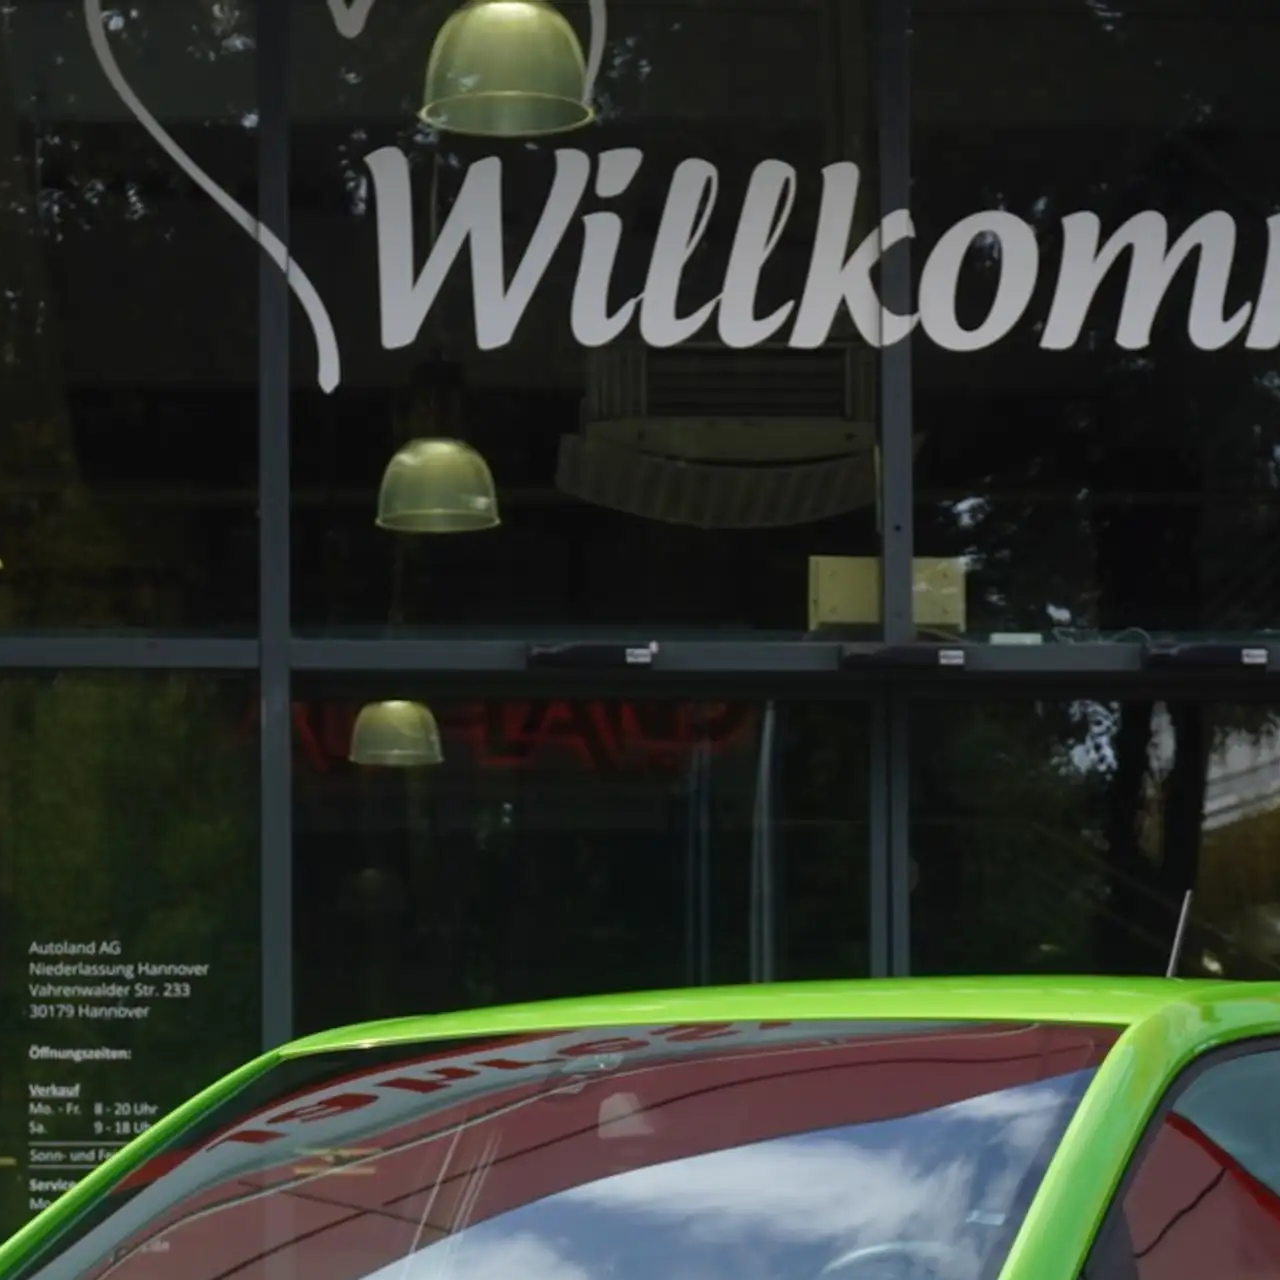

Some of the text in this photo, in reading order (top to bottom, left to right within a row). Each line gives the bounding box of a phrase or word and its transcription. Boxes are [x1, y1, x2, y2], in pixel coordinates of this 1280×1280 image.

[29, 941, 121, 955] Autoland AG
[29, 962, 210, 979] Niederlassung Hannover
[29, 983, 191, 997] Vahrenwalder Str. 233
[29, 1004, 150, 1018] 30179 Hannover
[28, 1044, 132, 1062] Öffnungszeiten:
[29, 1083, 80, 1097] Verkauf
[29, 1102, 54, 1115] Mo.
[66, 1102, 81, 1115] Fr.
[114, 1102, 131, 1115] 20
[133, 1102, 158, 1115] Uhr
[29, 1121, 47, 1134] Sa.
[30, 1149, 67, 1162] Sonn-
[70, 1149, 95, 1162] und
